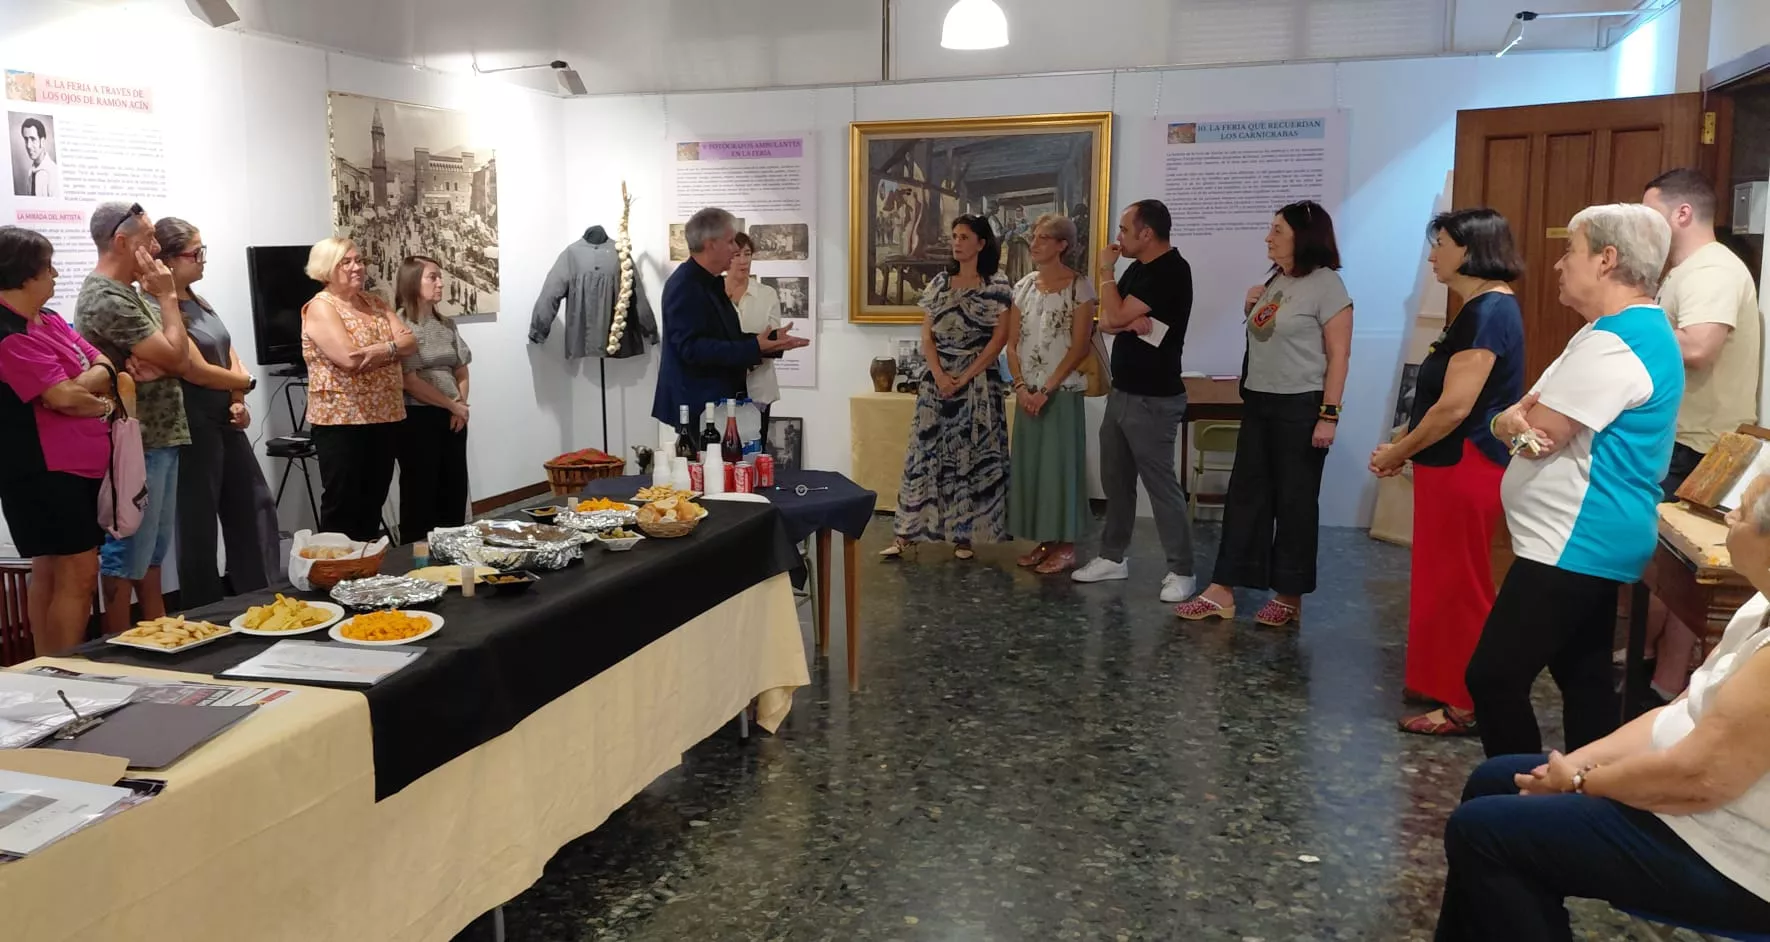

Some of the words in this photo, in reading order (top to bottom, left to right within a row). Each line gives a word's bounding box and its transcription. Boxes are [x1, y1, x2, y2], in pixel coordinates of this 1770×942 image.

[54, 80, 66, 89] LA
[66, 81, 92, 93] FERIA
[93, 85, 100, 94] A
[132, 88, 145, 98] DE
[42, 90, 60, 101] LOS
[60, 92, 82, 105] OJOS
[83, 95, 95, 105] DE
[1209, 124, 1220, 132] LA
[1221, 122, 1246, 131] FERIA
[1247, 121, 1266, 131] QUE
[1267, 120, 1321, 130] RECUERDAN
[1220, 132, 1238, 140] LOS
[17, 213, 25, 221] LA
